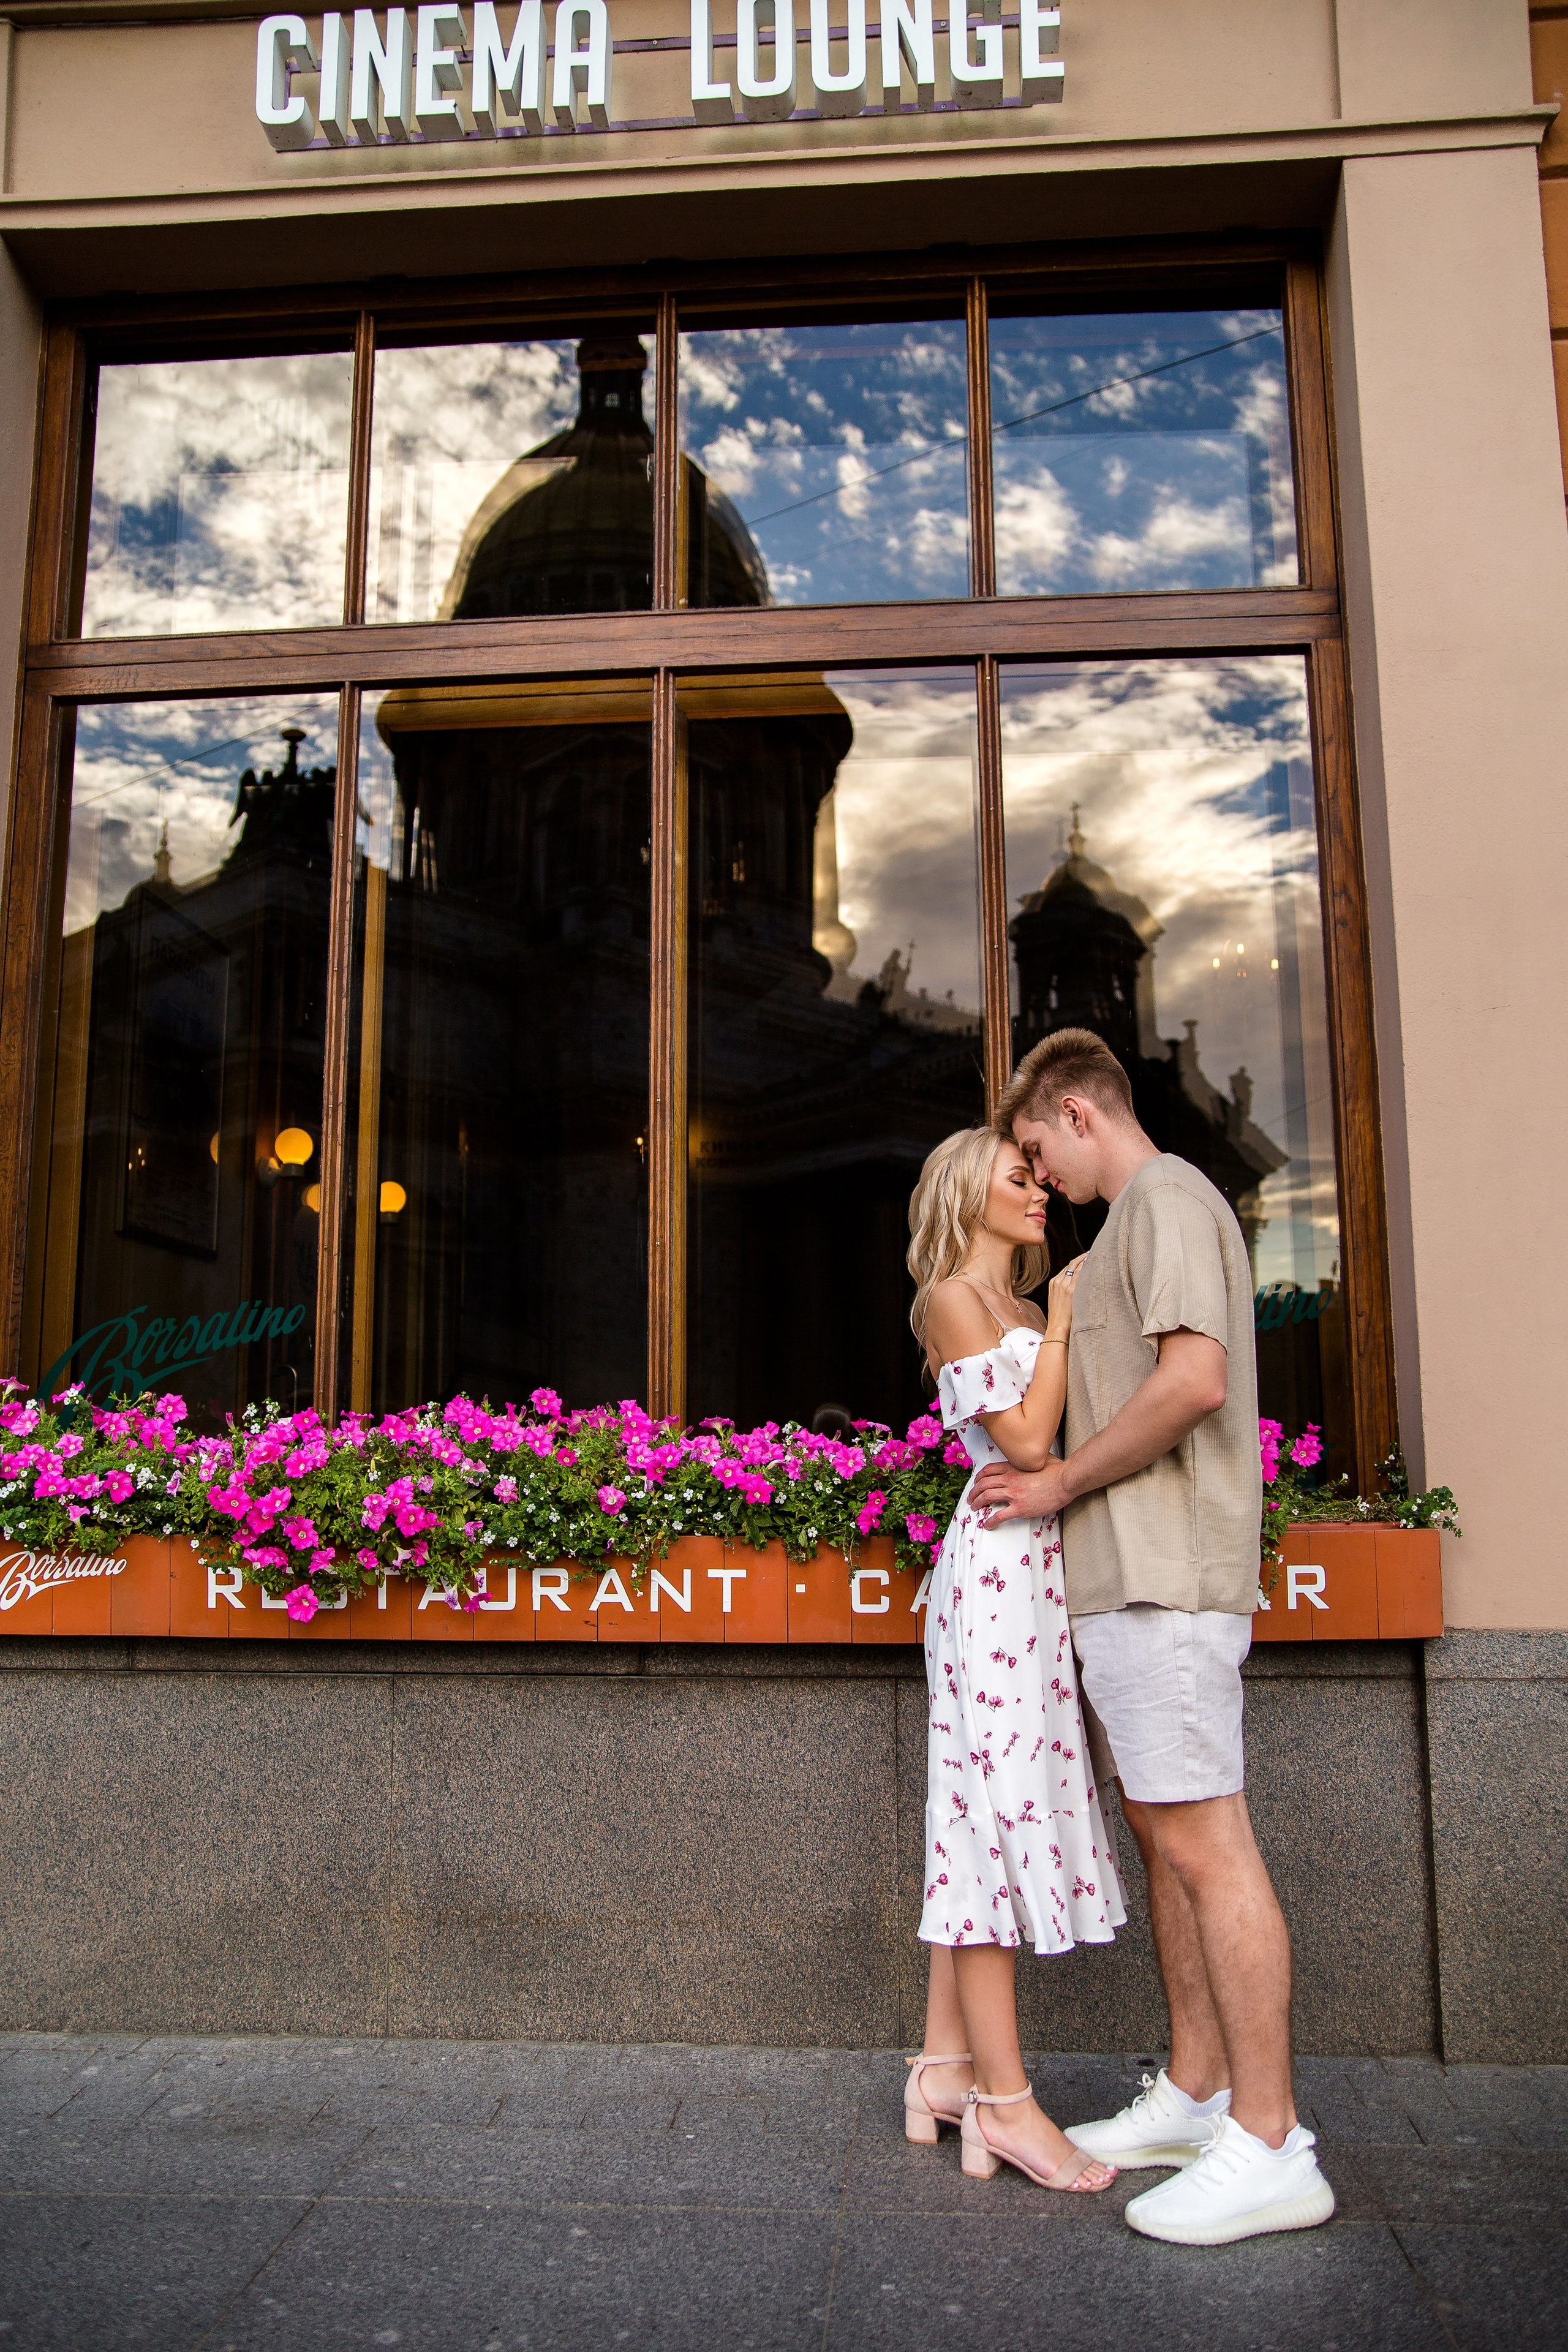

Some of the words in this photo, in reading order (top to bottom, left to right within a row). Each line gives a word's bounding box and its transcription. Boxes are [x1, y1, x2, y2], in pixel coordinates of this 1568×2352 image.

[255, 0, 608, 126] CINEMA
[690, 0, 1065, 100] LOUNGE
[33, 1299, 306, 1432] Borsalino
[0, 1550, 127, 1611] Borsalino
